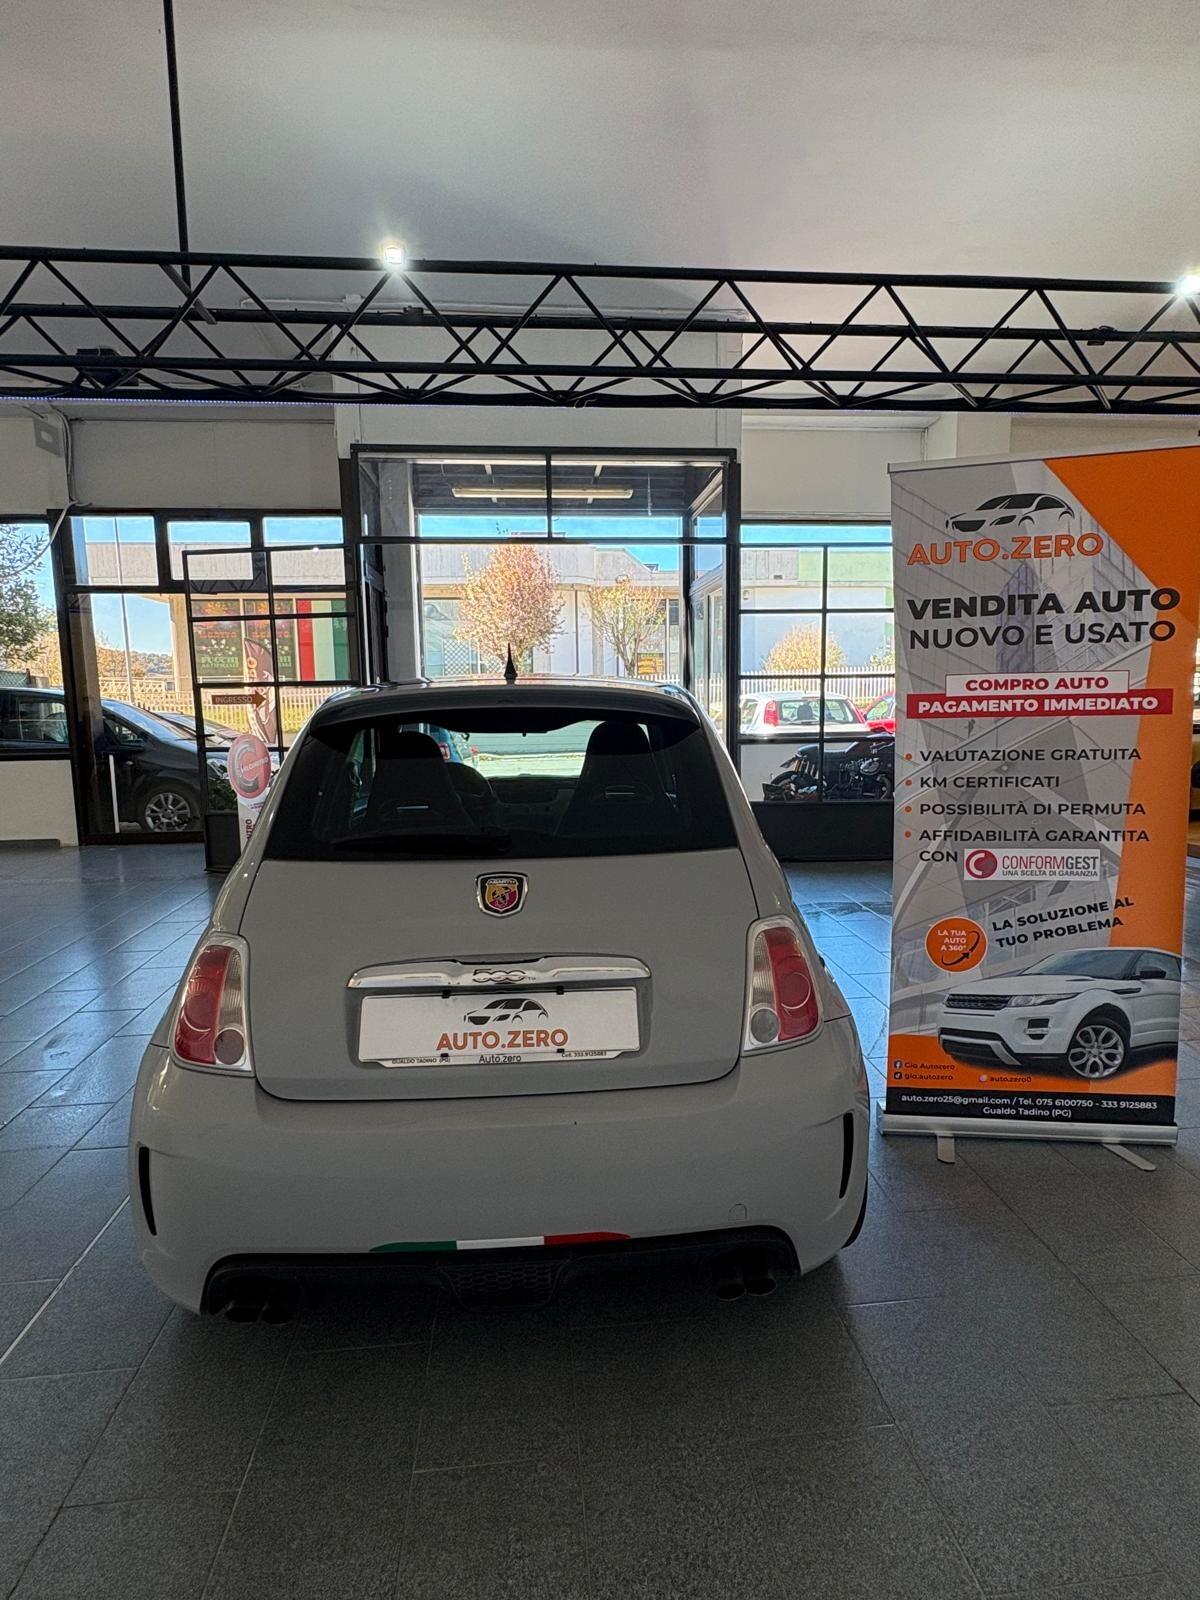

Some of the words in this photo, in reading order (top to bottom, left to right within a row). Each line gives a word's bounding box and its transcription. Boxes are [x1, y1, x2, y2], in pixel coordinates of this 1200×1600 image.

[906, 532, 1104, 566] AUTO.ZERO
[906, 593, 1065, 620] VENDITA
[1075, 587, 1180, 613] AUTO
[910, 625, 1025, 650] NUOVO
[1035, 624, 1053, 645] E
[1065, 620, 1176, 644] USATO
[965, 678, 1049, 692] COMPRO
[1055, 676, 1109, 690] AUTO
[215, 695, 253, 704] INGRESSO
[918, 698, 1039, 714] PAGAMENTO
[1044, 696, 1159, 711] IMMEDIATO
[919, 749, 1046, 762] VALUTAZIONE
[1050, 748, 1142, 761] GRATUITA
[920, 776, 947, 789] KM
[952, 775, 1060, 788] CERTIFICATI
[920, 800, 1027, 816] POSSIBILITÀ
[1033, 803, 1052, 815] DI
[1057, 803, 1146, 815] PERMUTA
[918, 827, 1039, 842] AFFIDABILITÀ
[1045, 830, 1150, 842] GARANTITA
[919, 850, 958, 863] CON
[1002, 855, 1099, 870] CONFORMGEST
[991, 921, 1013, 932] LA
[1016, 901, 1109, 928] SOLUZIONE
[1113, 897, 1134, 909] AL
[995, 934, 1029, 949] TUO
[1032, 916, 1124, 942] PROBLEMA
[436, 1028, 569, 1052] AUTO.ZERO
[904, 1062, 918, 1070] Gio
[901, 1094, 1010, 1106] auto.zero25@gmail.com
[1018, 1097, 1034, 1106] Tel.
[1035, 1098, 1053, 1106] 075
[1055, 1099, 1094, 1108] 6100750
[1101, 1100, 1118, 1108] 333
[1120, 1101, 1157, 1110] 9125883
[983, 1106, 1017, 1115] Gualdo
[1018, 1107, 1050, 1116] Tadino
[1051, 1108, 1072, 1118] (PG)
